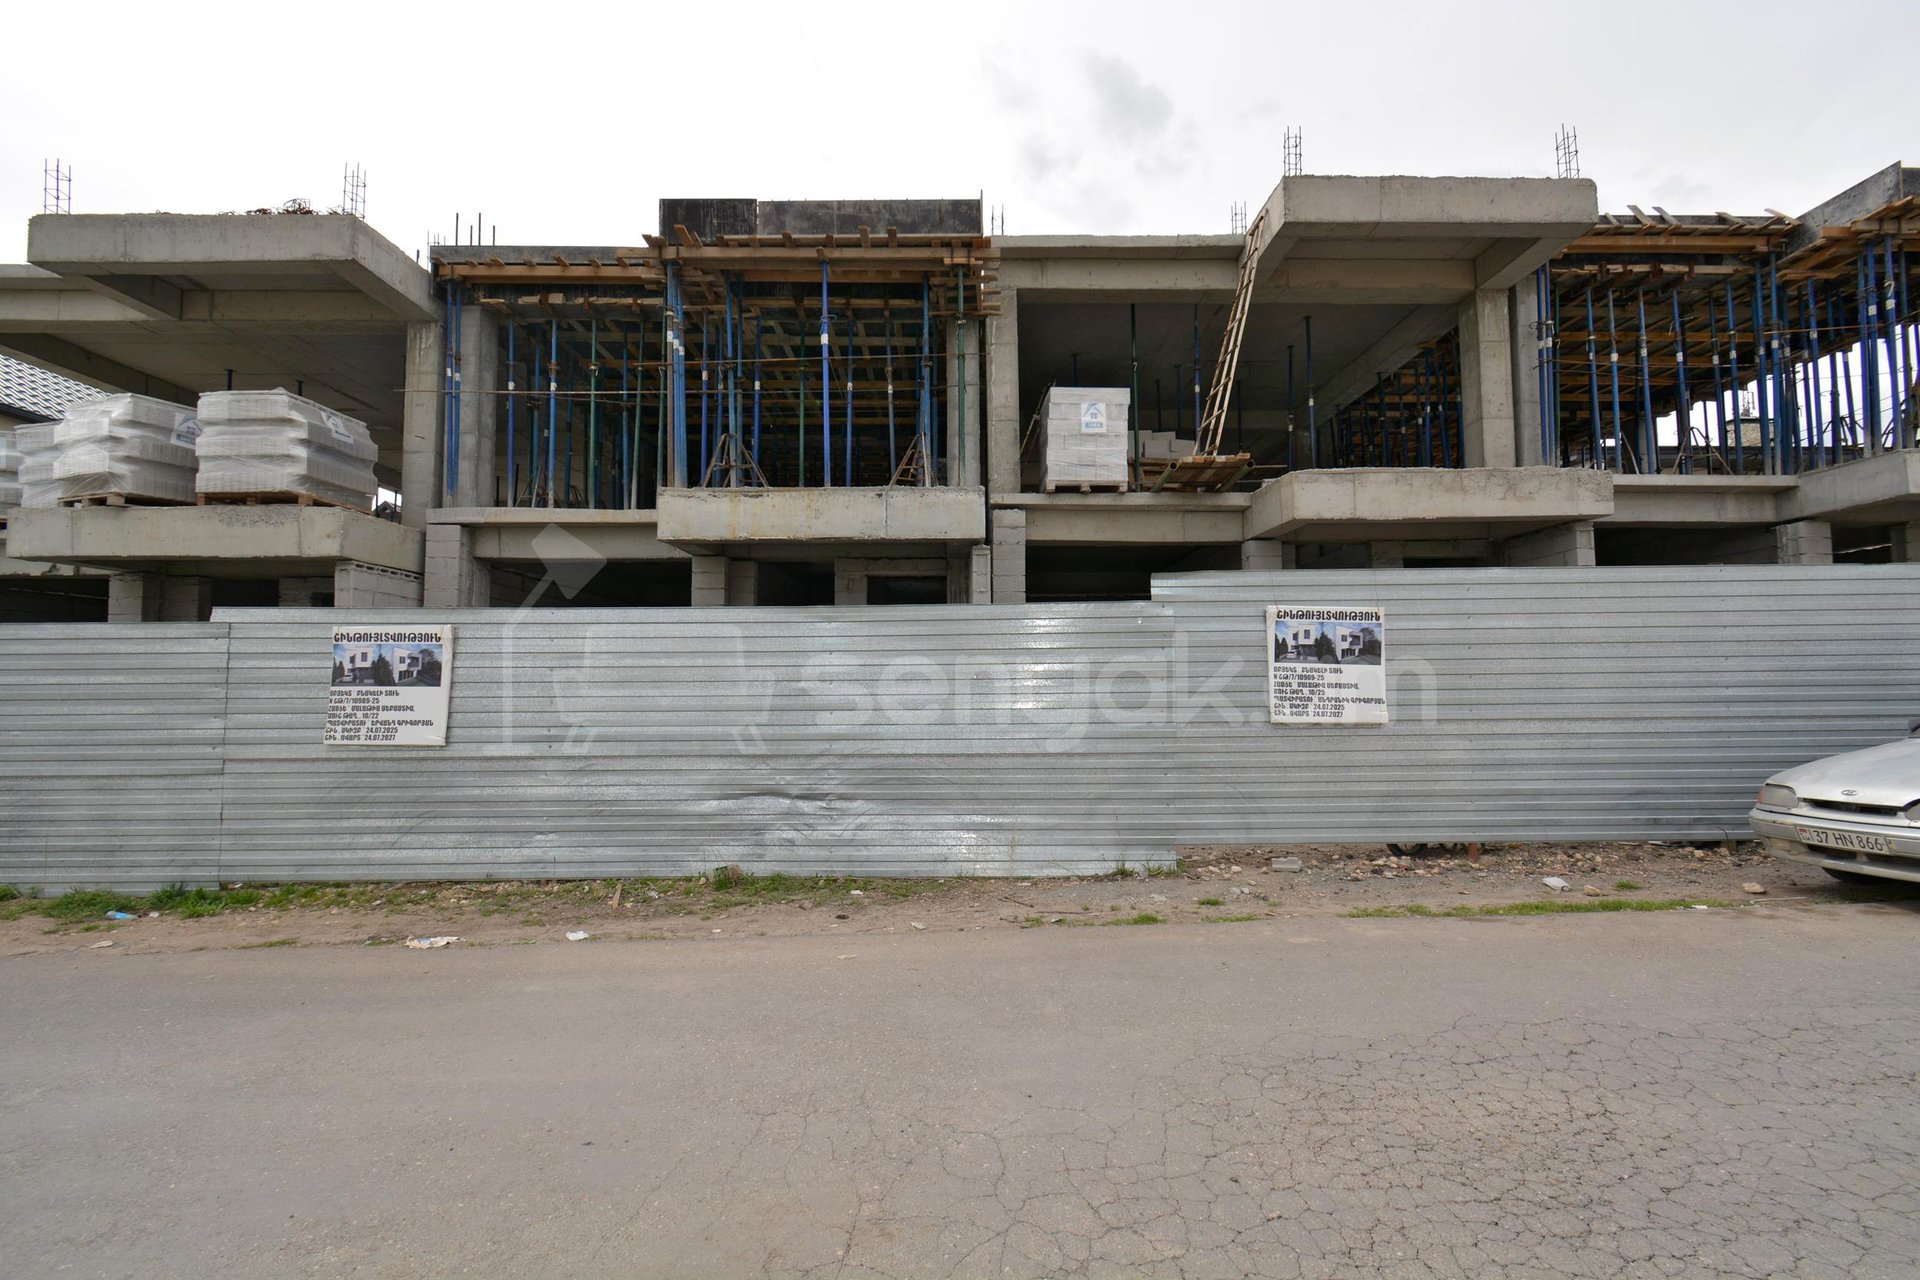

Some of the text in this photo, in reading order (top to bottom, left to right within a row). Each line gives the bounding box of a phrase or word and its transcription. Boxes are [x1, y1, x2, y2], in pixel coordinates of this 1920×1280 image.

[1277, 610, 1380, 621] ՇԻՆԹՈՒՅԼՏՎՈՒԹՅՈՒՆ
[334, 632, 441, 642] ՇԻՆԹՈՒՅԼՏՎՈՒԹՅՈՒՆ
[1813, 830, 1883, 851] 37 HN 866
